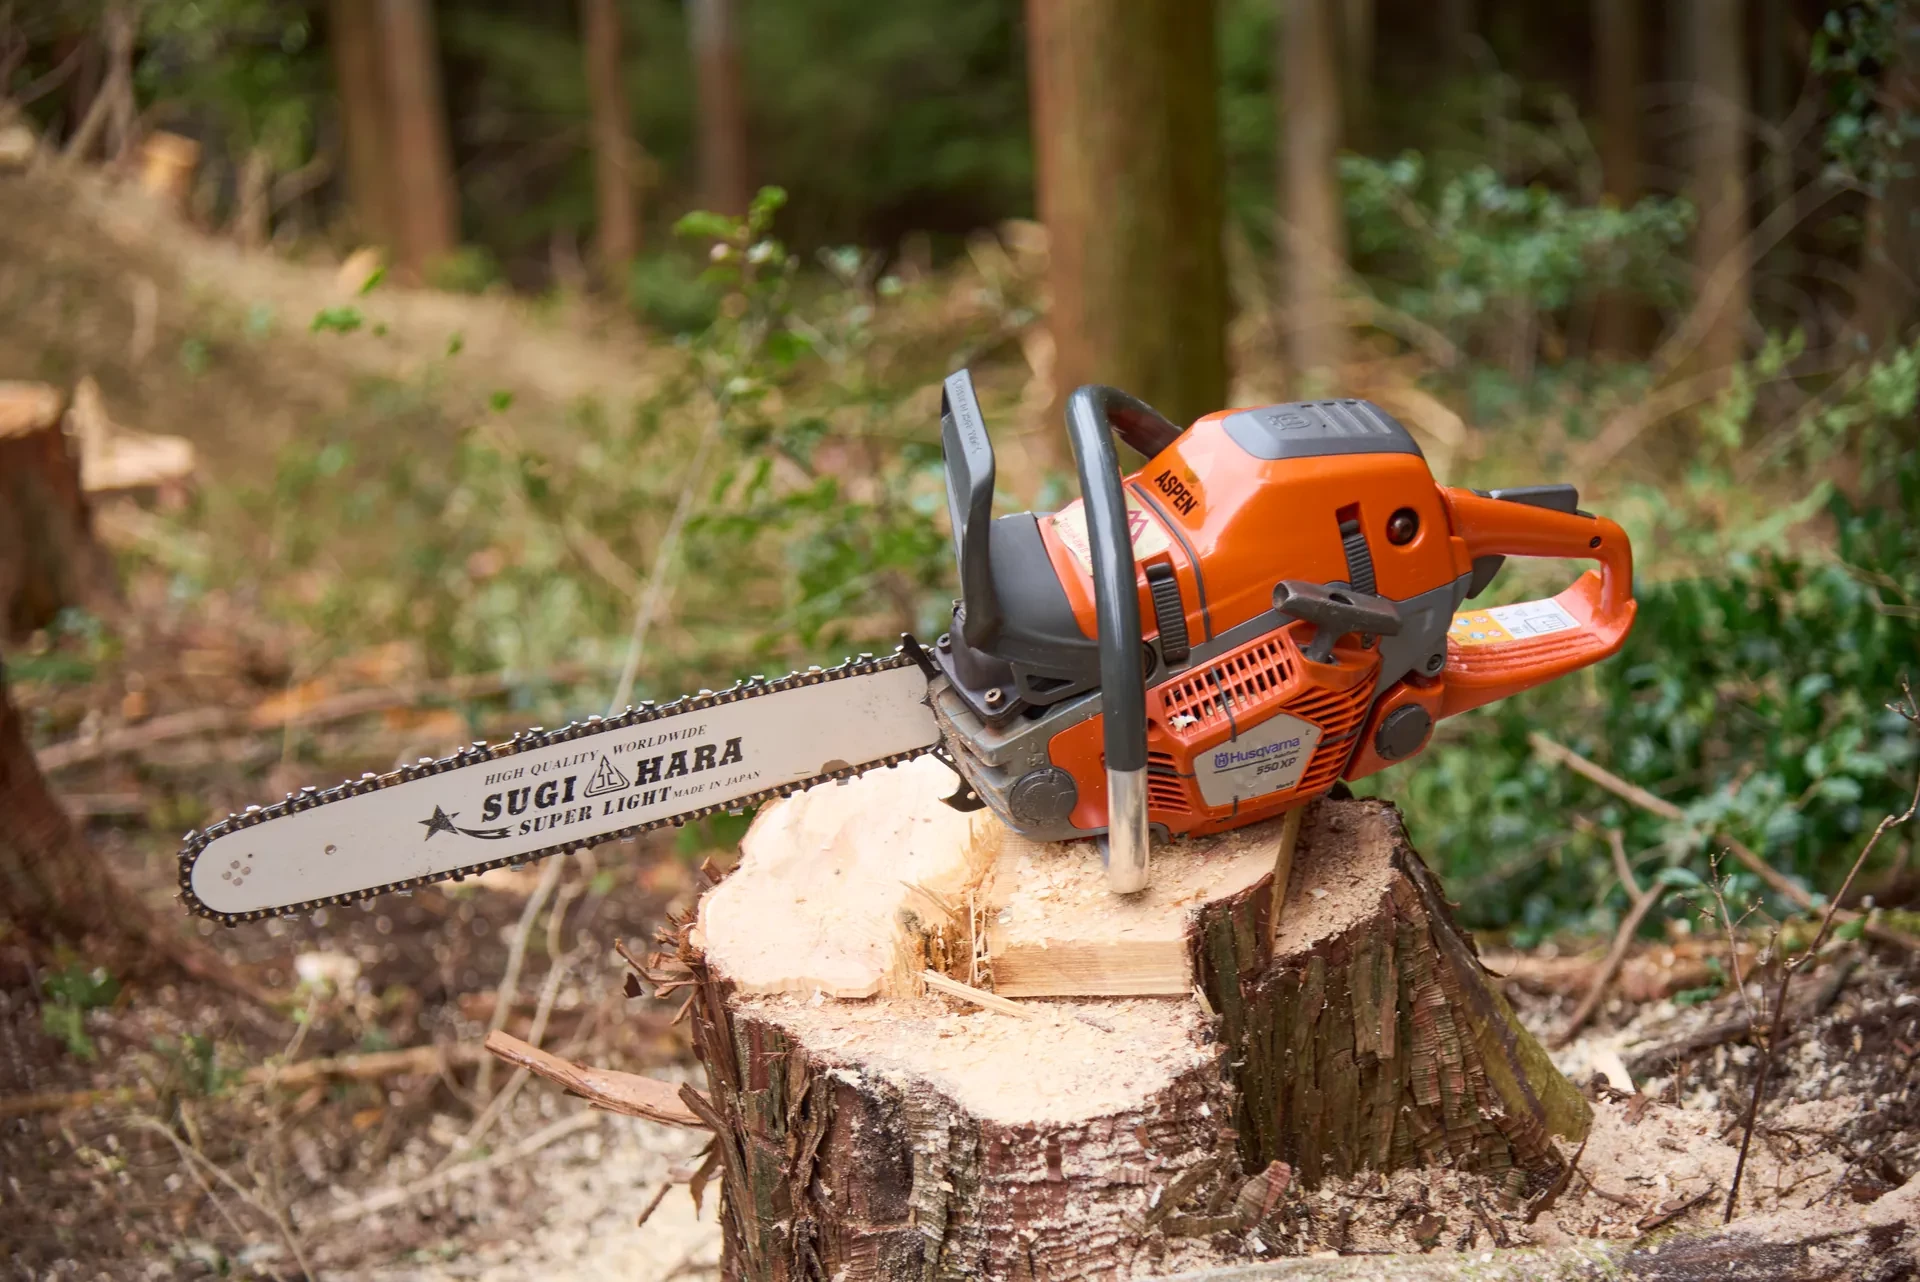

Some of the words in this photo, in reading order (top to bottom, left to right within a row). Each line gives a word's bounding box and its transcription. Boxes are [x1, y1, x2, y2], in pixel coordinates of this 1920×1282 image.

[1154, 469, 1198, 516] ASPEN
[612, 724, 707, 755] WORLDWIDE
[1229, 737, 1300, 763] Husqvarna
[484, 766, 524, 786] HIGH
[530, 750, 599, 776] QUALITY
[634, 736, 743, 786] HARA
[1256, 762, 1279, 775] 550
[1280, 757, 1297, 769] XP
[481, 775, 577, 823] SUGI
[673, 783, 706, 799] MADE
[709, 780, 722, 790] IN
[724, 770, 761, 788] JAPAN
[518, 804, 592, 836] SUPER
[602, 786, 673, 816] LIGHT
